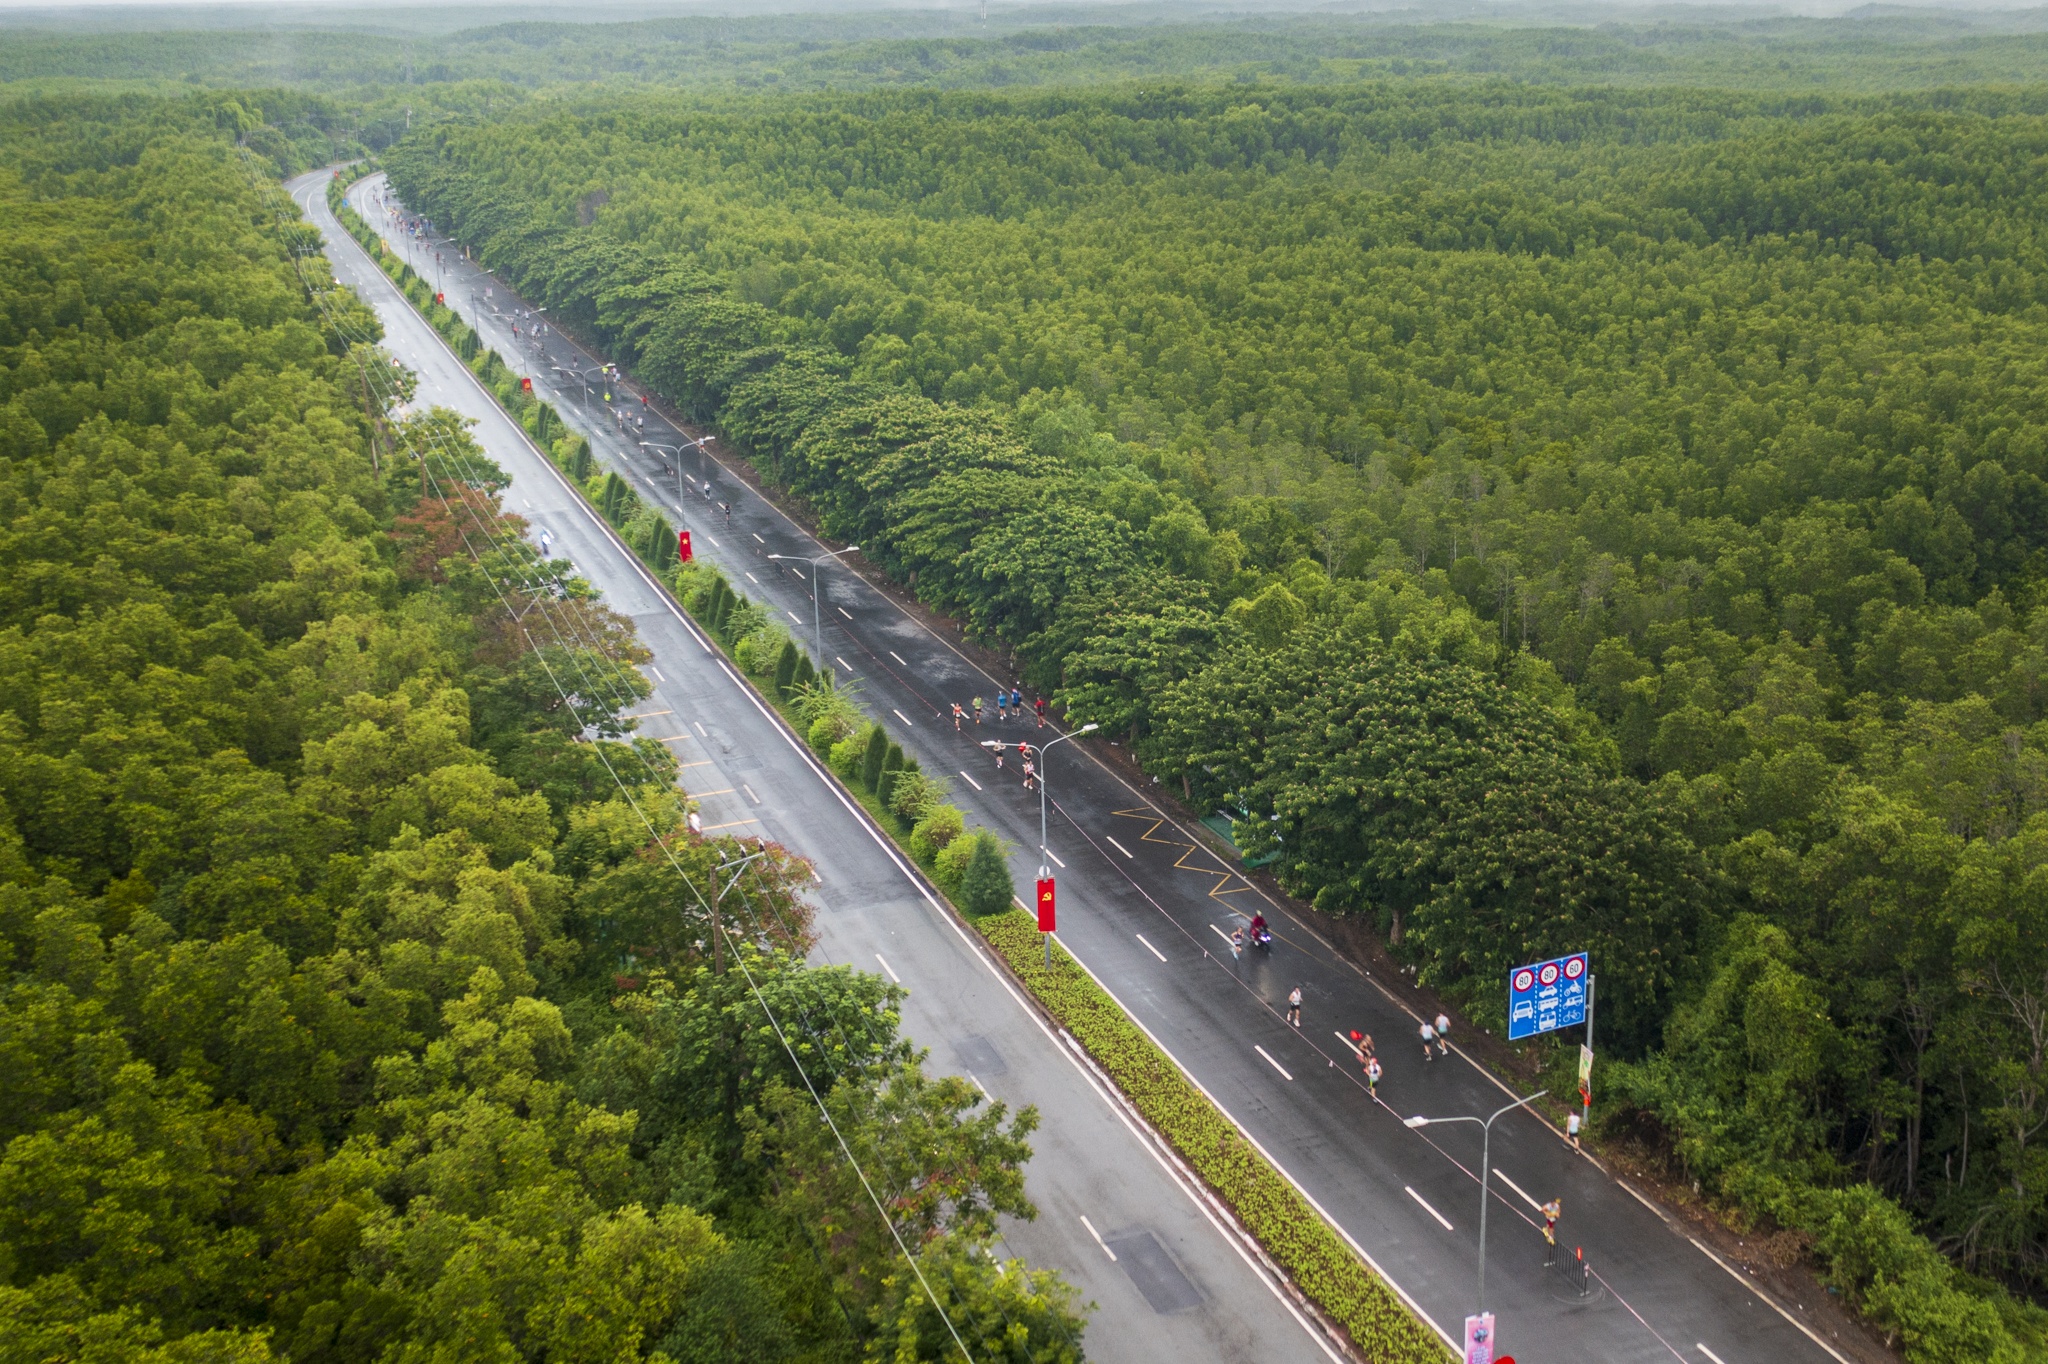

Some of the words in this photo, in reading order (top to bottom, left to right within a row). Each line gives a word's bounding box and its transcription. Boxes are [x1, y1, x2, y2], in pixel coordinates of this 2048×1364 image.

[1569, 963, 1579, 974] 60
[1544, 969, 1554, 980] 80
[1518, 975, 1529, 987] 80
